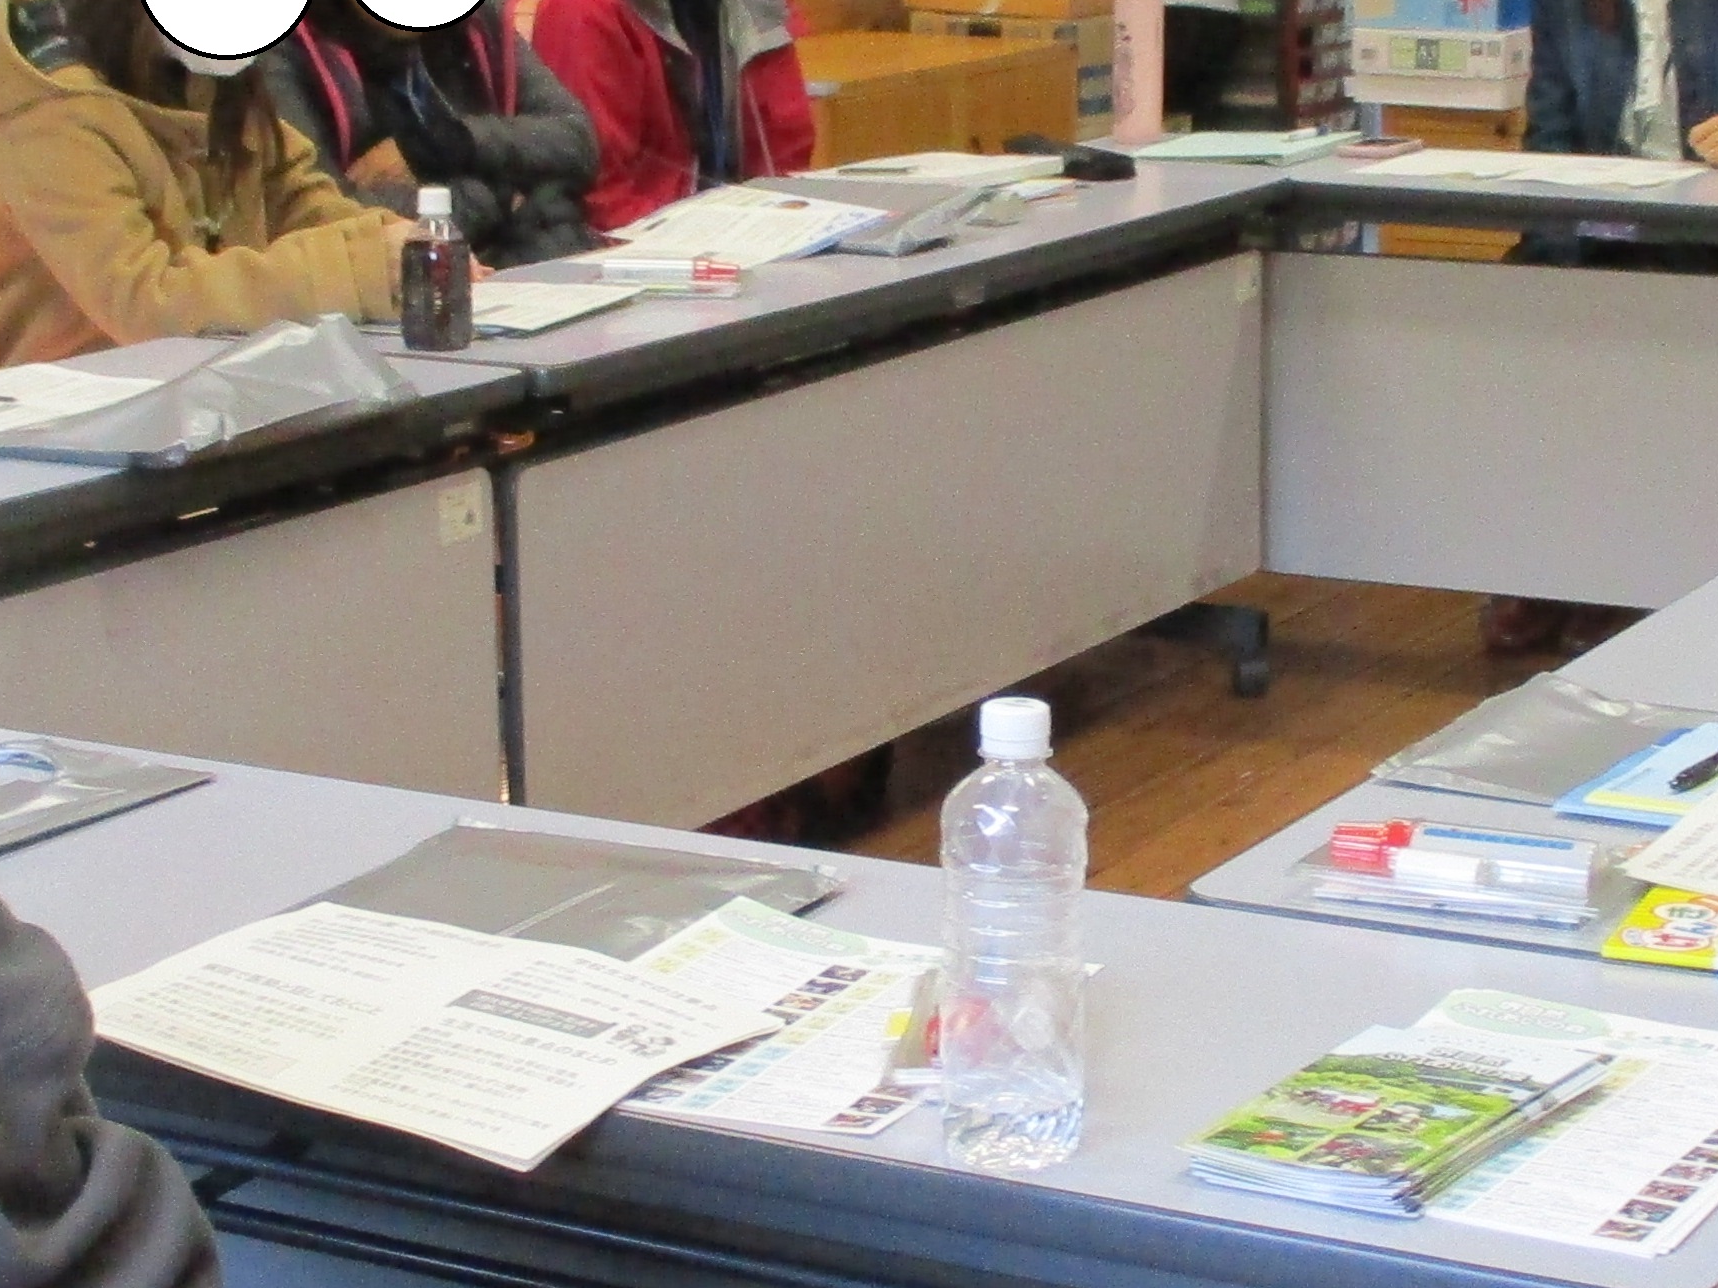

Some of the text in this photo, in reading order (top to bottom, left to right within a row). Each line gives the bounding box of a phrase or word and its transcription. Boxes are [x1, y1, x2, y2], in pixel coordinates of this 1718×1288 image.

[440, 1017, 618, 1066] 生活での注意点のまとめ
